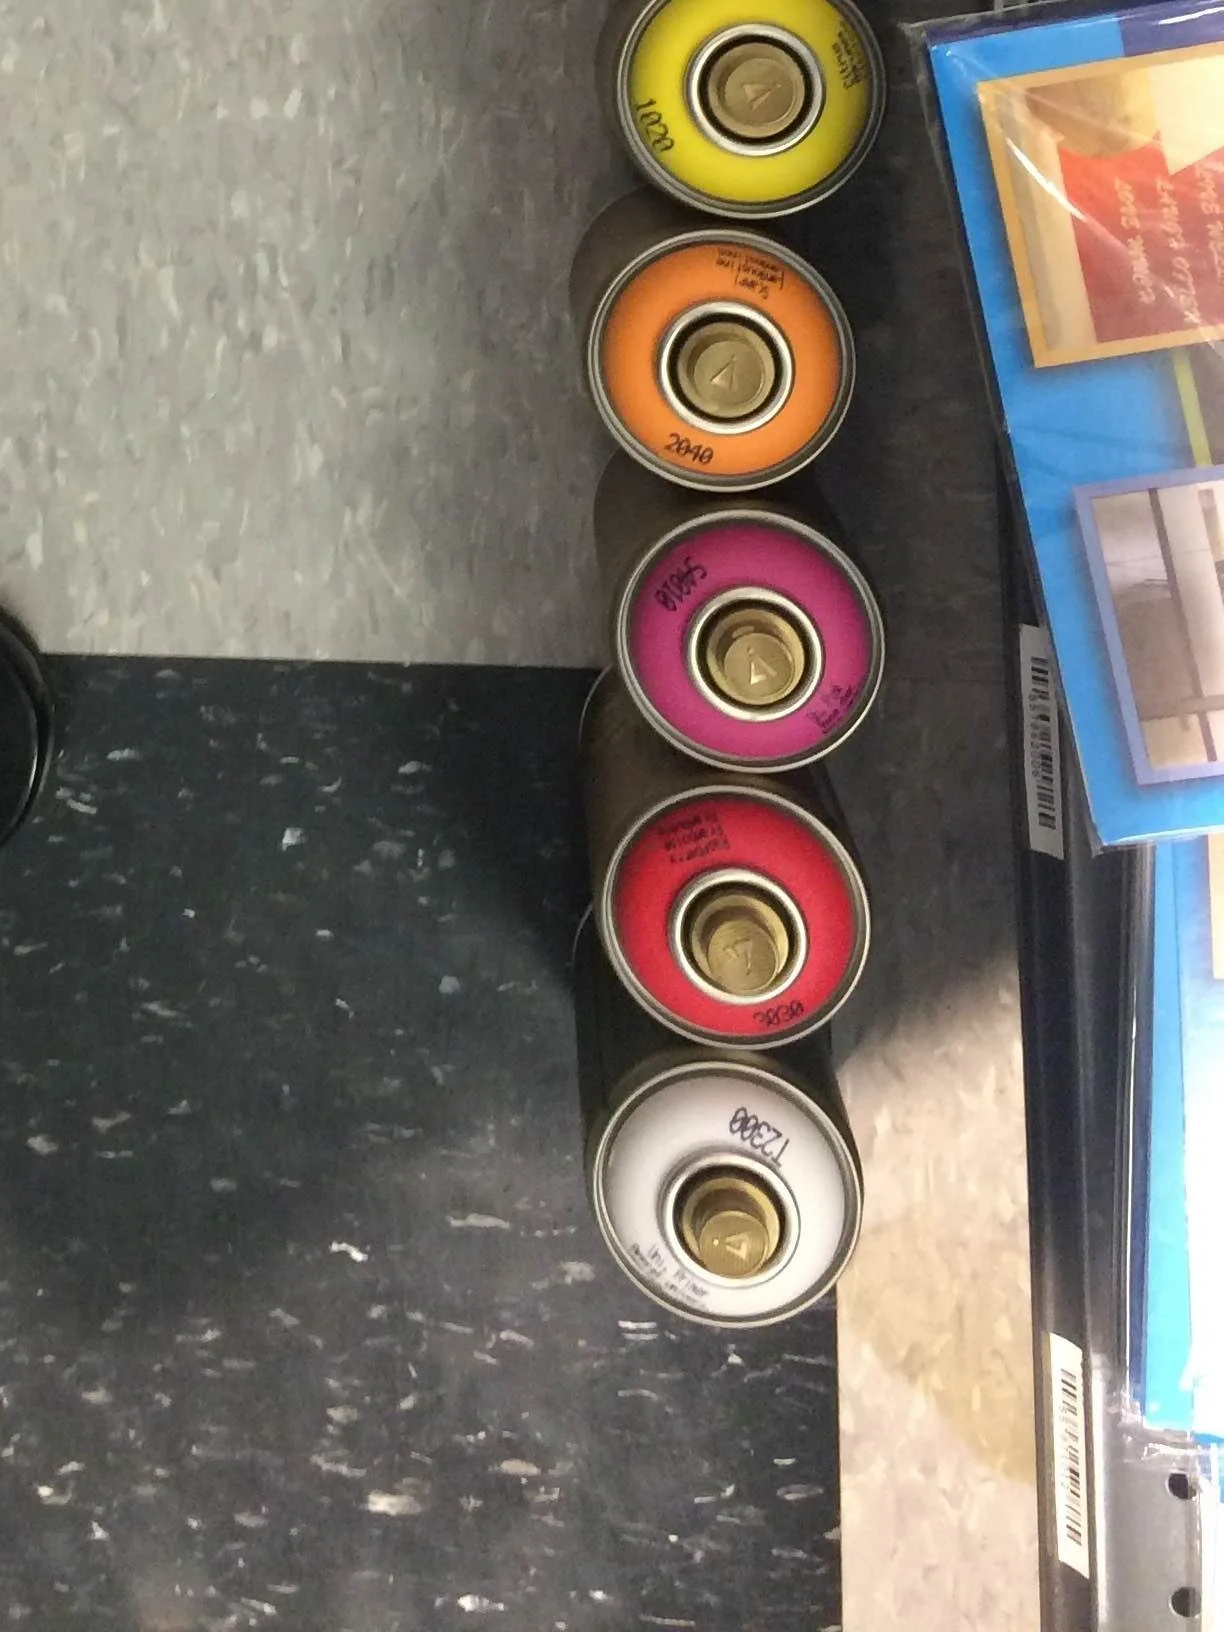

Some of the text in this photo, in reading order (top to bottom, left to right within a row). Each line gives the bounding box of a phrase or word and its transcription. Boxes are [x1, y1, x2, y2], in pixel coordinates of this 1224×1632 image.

[633, 97, 675, 154] 1020
[664, 432, 714, 466] 2040
[727, 1106, 791, 1168] T2300
